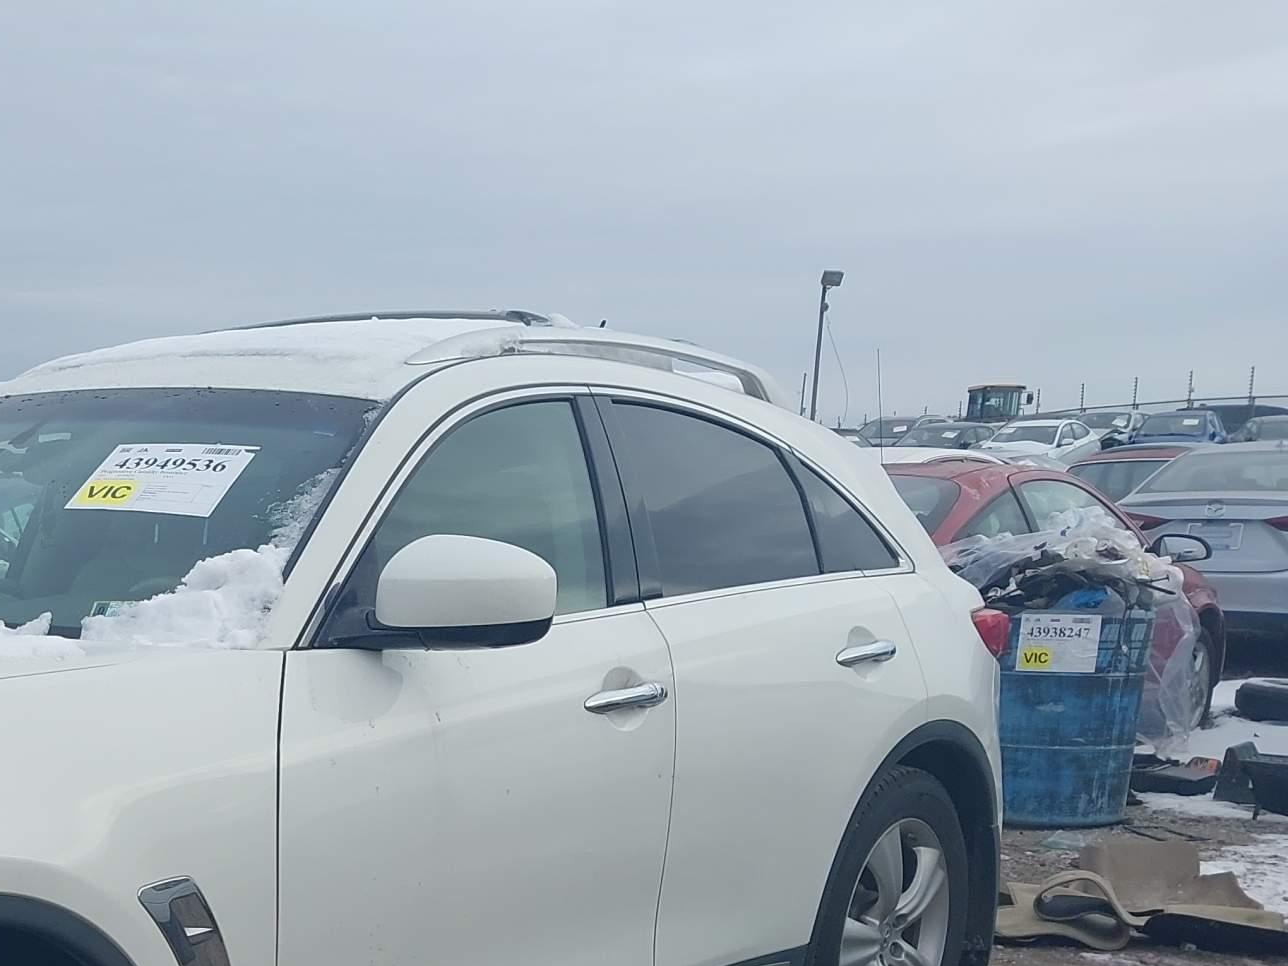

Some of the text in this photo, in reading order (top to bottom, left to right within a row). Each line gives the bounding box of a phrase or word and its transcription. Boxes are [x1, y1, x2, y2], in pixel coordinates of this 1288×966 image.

[115, 457, 232, 473] 43949536
[86, 485, 131, 499] VIC
[1026, 626, 1091, 639] 43938247
[1023, 652, 1049, 664] VIC
